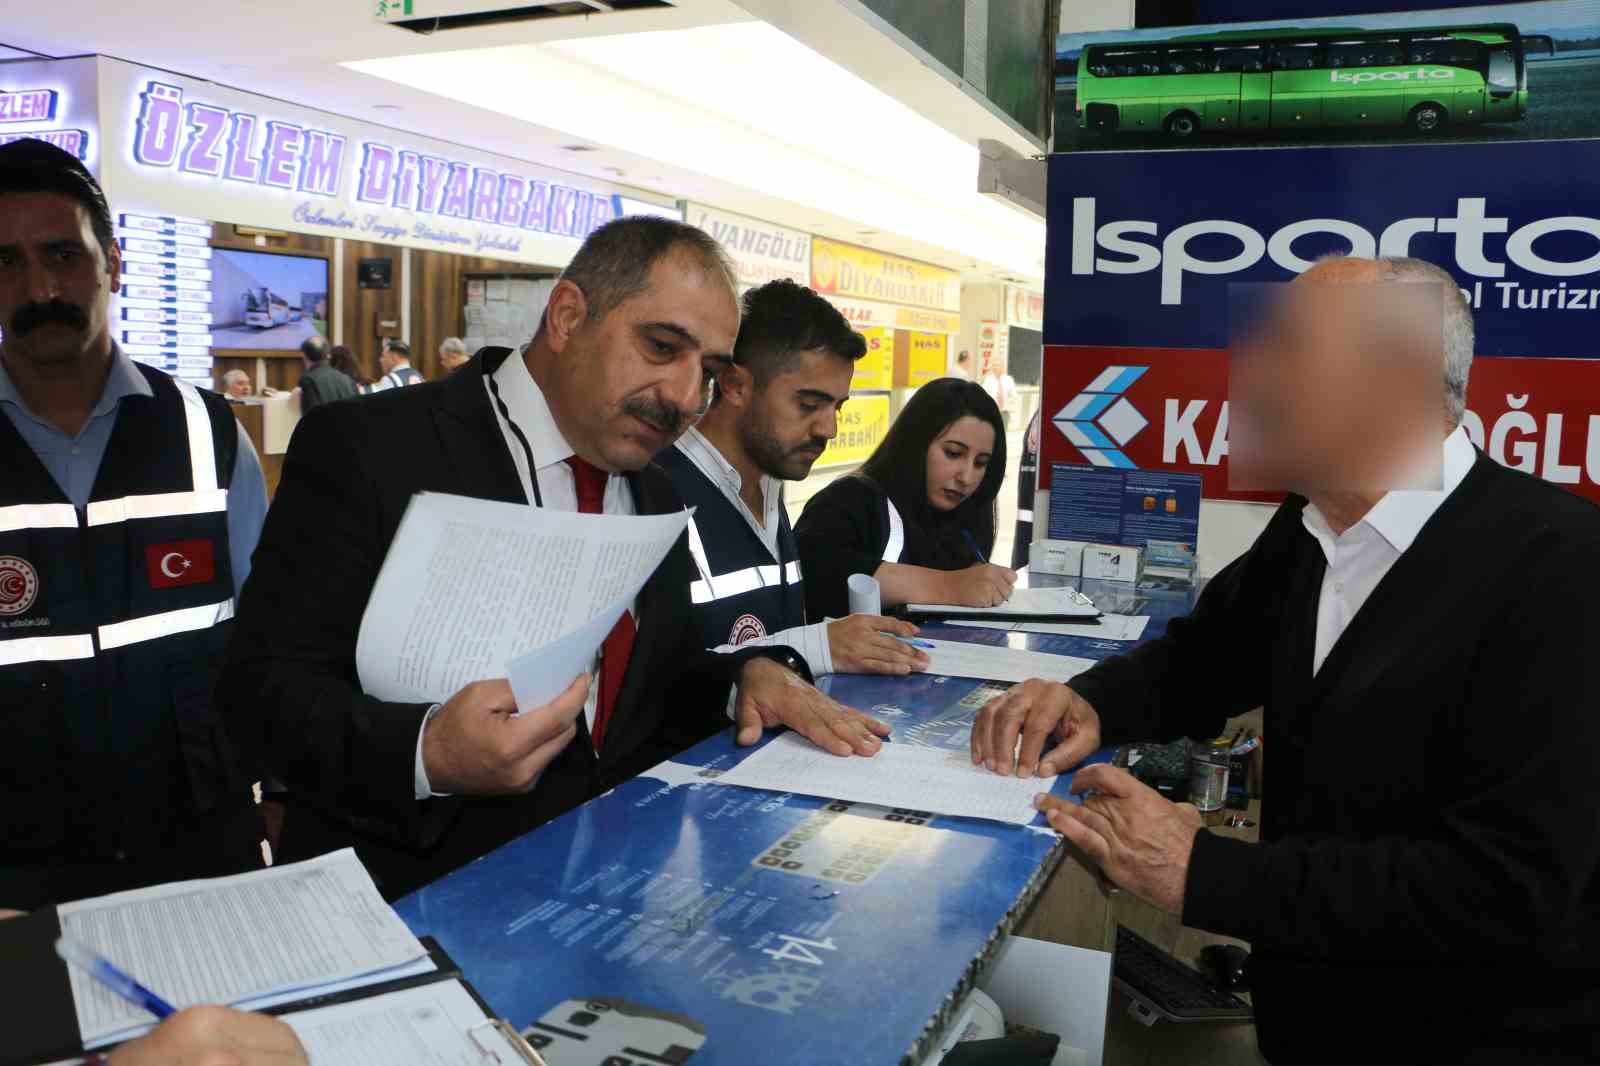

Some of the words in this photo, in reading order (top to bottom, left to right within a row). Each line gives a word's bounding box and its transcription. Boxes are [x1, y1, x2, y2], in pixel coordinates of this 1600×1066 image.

[1331, 67, 1456, 85] Isparta
[133, 81, 348, 197] ÖZLEM
[711, 220, 808, 263] VANGÖLÜ
